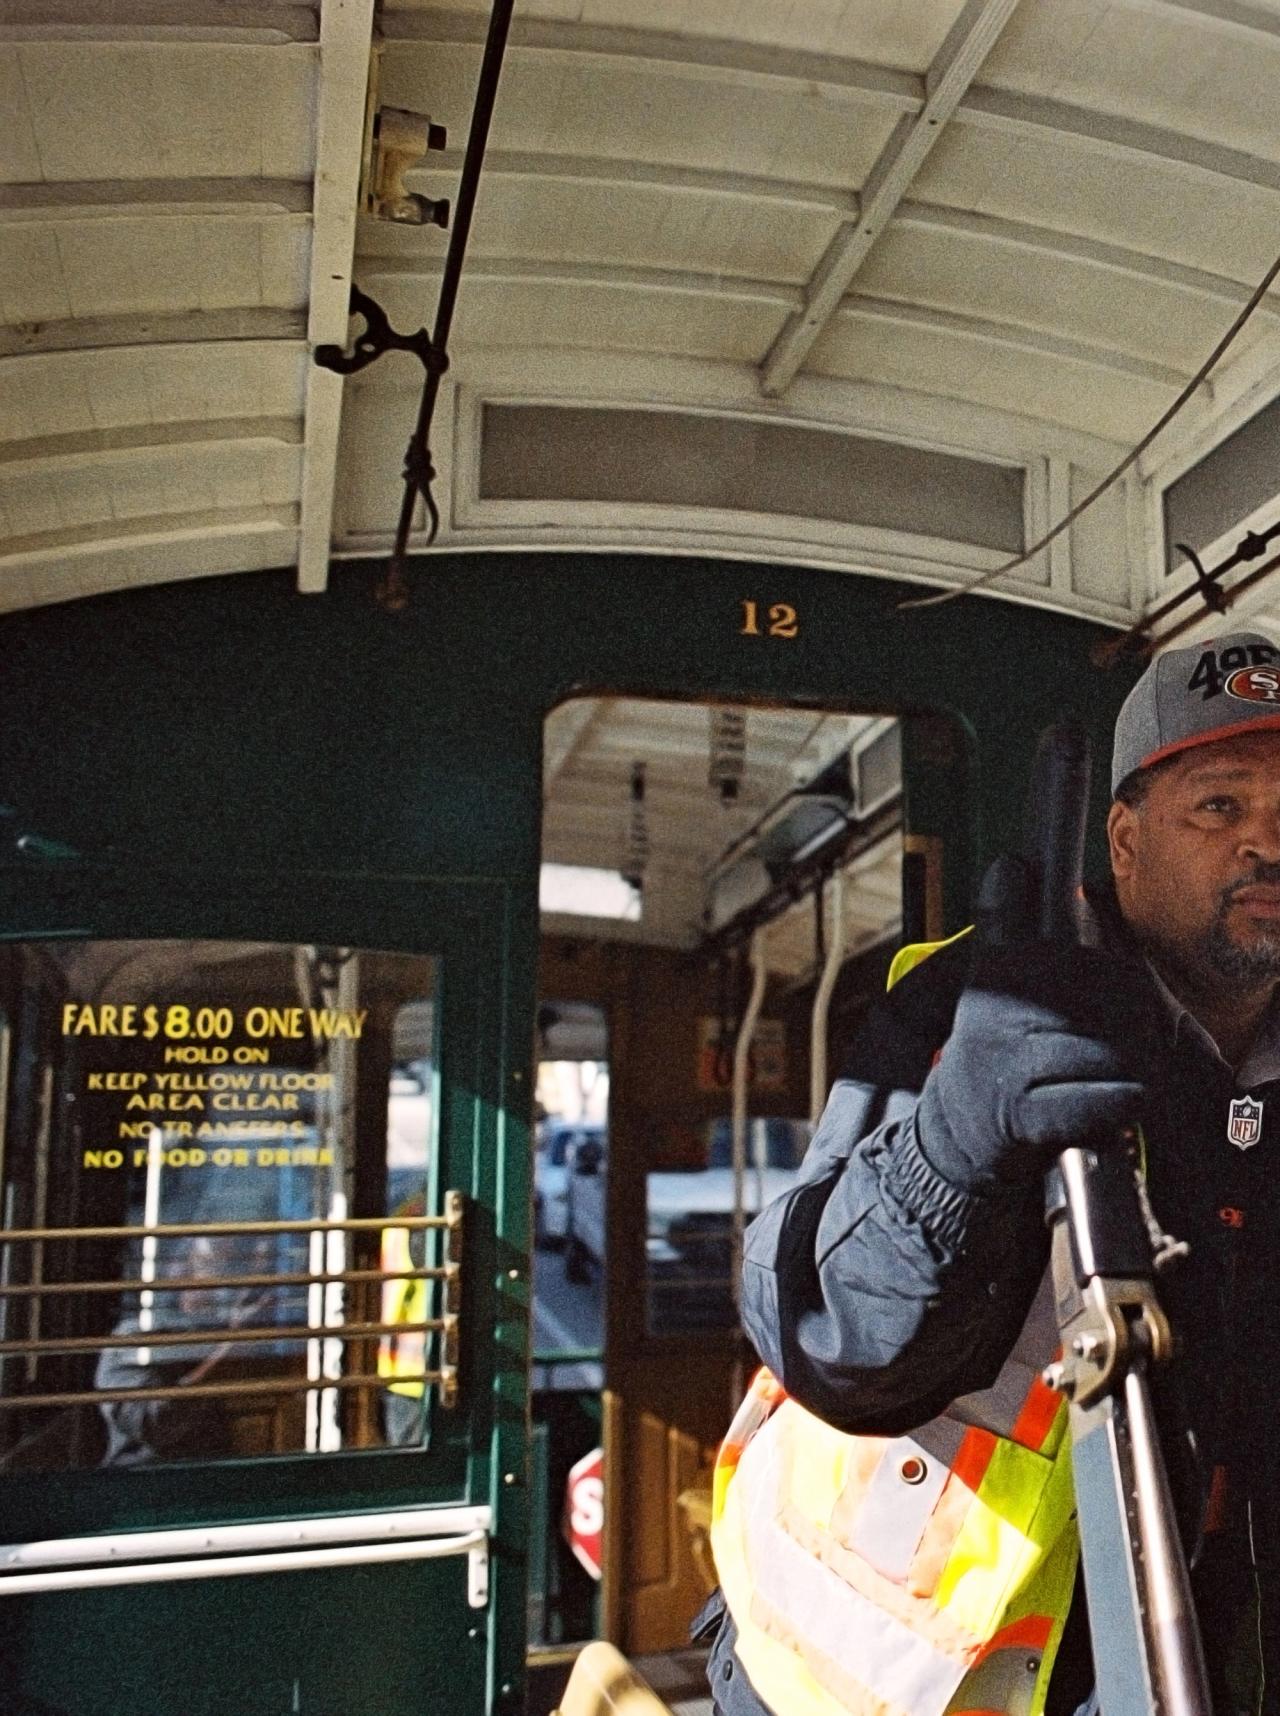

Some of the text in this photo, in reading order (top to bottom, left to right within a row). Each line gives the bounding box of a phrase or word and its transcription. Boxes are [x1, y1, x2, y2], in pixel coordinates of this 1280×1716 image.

[739, 600, 798, 638] 12
[62, 1003, 138, 1036] FARE
[245, 1007, 305, 1038] ONE
[309, 1008, 368, 1039] WAY
[164, 1047, 270, 1064] HOLD ON
[88, 1072, 334, 1091] KEEP YELLOW FLOOR
[126, 1093, 299, 1111] AREA CLEAR
[119, 1121, 156, 1138] NO
[1233, 1119, 1257, 1140] NFL
[84, 1149, 124, 1168] NO
[211, 1147, 249, 1168] OR
